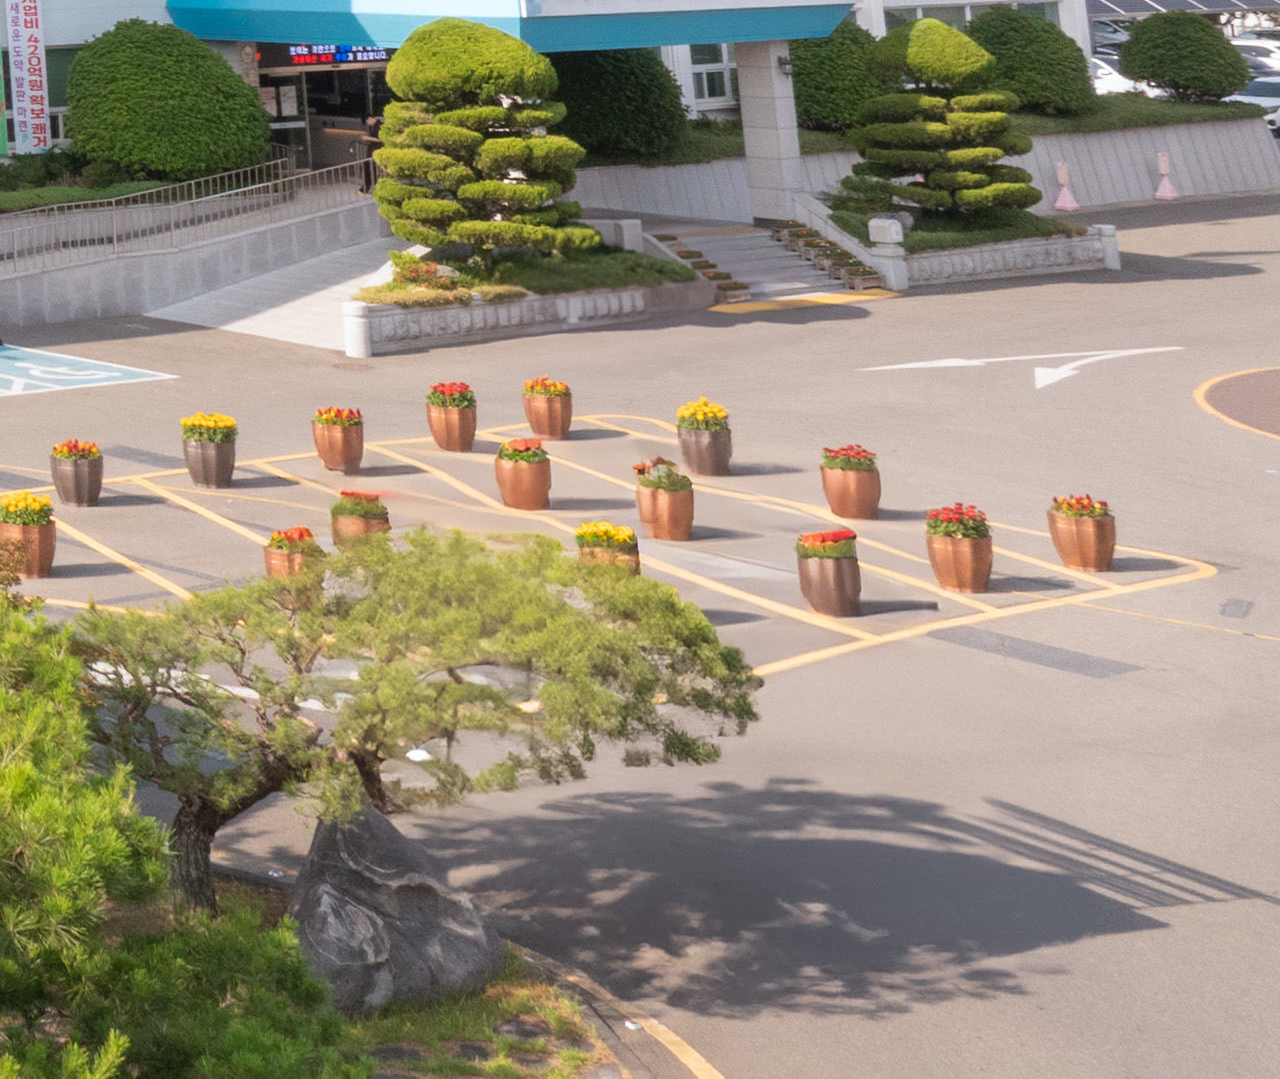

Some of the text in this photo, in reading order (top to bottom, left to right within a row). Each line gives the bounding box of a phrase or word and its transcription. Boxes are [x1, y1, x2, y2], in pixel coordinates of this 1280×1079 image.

[9, 2, 22, 42] 새로운
[12, 46, 24, 72] 도약
[26, 33, 44, 92] 420억원
[15, 76, 27, 103] 발판
[17, 106, 28, 133] 마련
[29, 94, 45, 120] 확보
[32, 123, 48, 148] 쾌거
